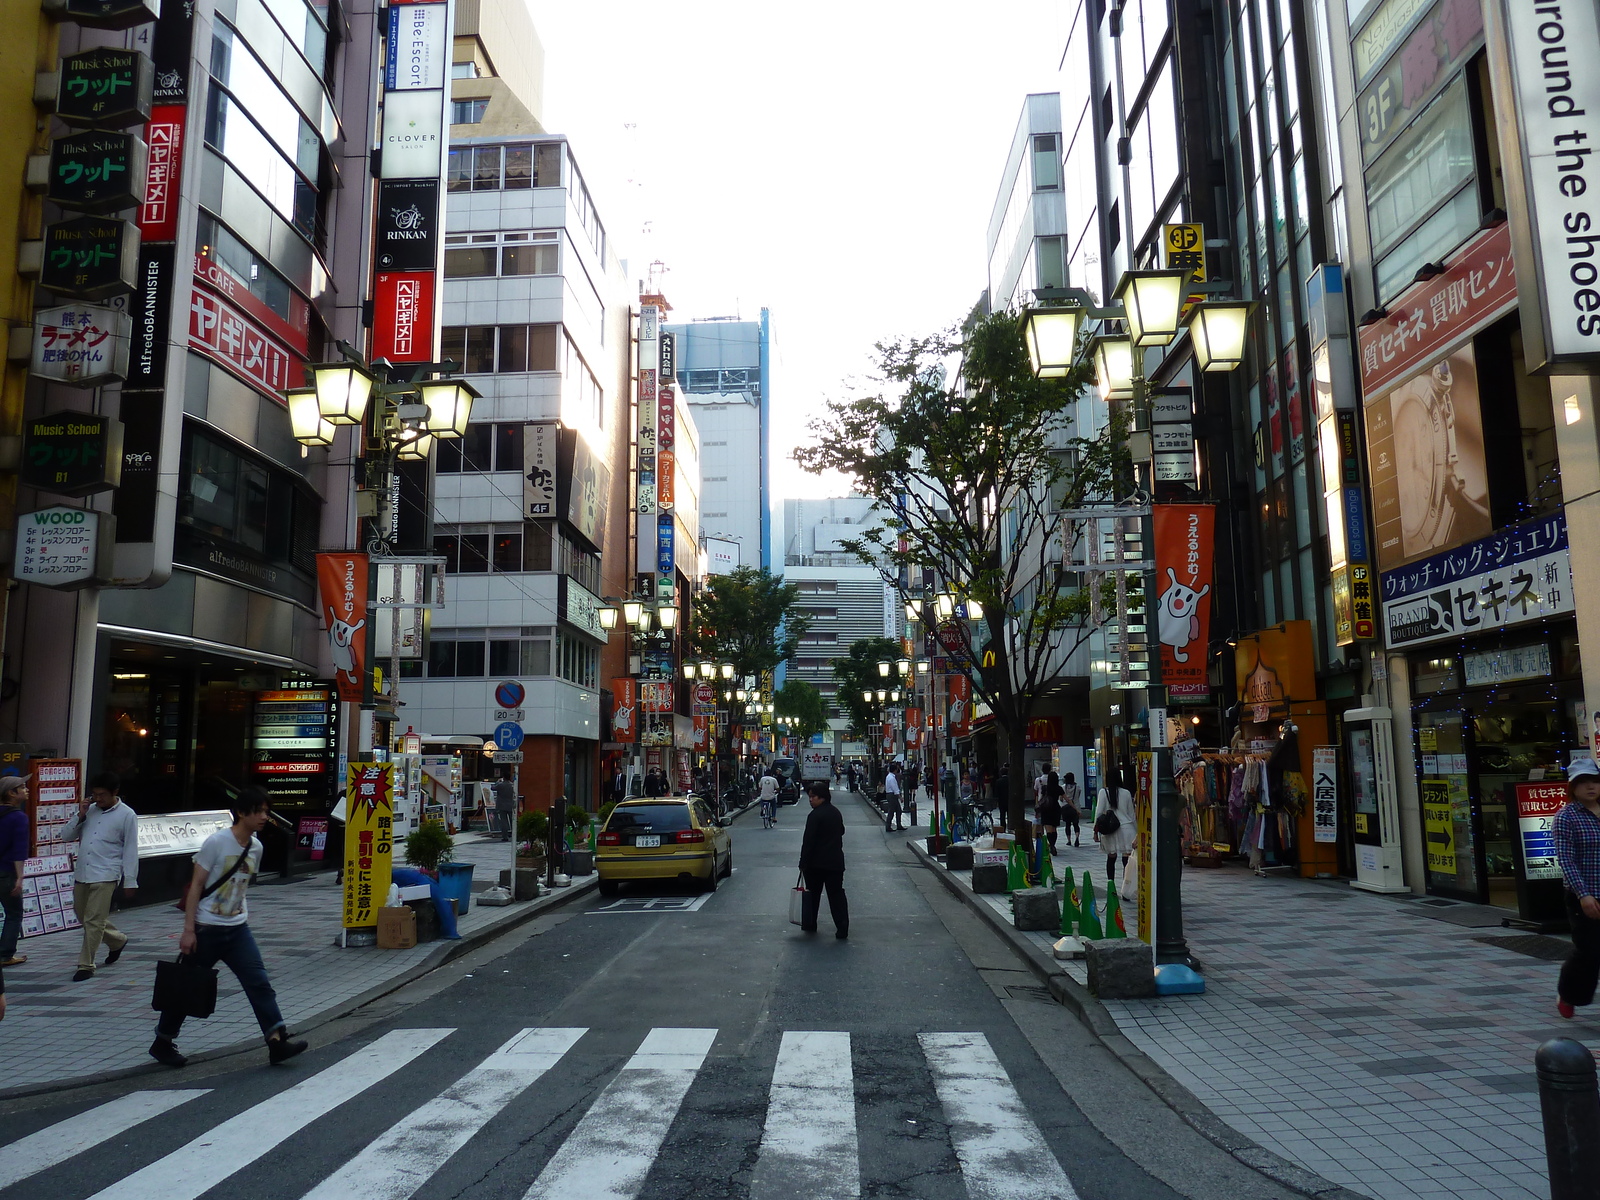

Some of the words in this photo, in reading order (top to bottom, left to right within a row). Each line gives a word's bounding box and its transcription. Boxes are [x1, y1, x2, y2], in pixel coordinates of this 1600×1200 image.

[138, 29, 148, 43] 4
[1362, 6, 1390, 54] Nail
[71, 59, 101, 71] Music
[103, 56, 132, 67] School
[1533, 0, 1586, 118] round
[67, 72, 132, 97] ウッド
[153, 88, 184, 97] RINKAN
[92, 102, 105, 112] 4F
[1367, 77, 1391, 142] 3F
[389, 134, 436, 142] CLOVER
[63, 144, 89, 154] Music
[93, 139, 125, 151] School
[59, 157, 126, 184] ウッド
[1553, 130, 1592, 198] the
[85, 190, 96, 199] 3F
[55, 229, 83, 240] Music
[88, 226, 117, 239] School
[387, 231, 427, 240] RINKAN
[1173, 229, 1195, 247] 3F
[51, 243, 116, 268] ウッド
[382, 256, 392, 264] 4F
[76, 274, 88, 284] 2F
[1563, 211, 1600, 337] shoes
[208, 267, 235, 296] CAFE
[62, 311, 92, 326] 熊本
[142, 260, 160, 374] alfredoBANNISTER
[42, 325, 110, 348] ラーメン
[43, 349, 103, 363] 肥後のれん
[662, 338, 671, 376] メトロ会館
[66, 364, 80, 375] 1F
[34, 424, 64, 436] Music
[67, 422, 101, 435] School
[30, 441, 100, 466] ウッド
[56, 472, 68, 483] B1
[526, 466, 554, 499] かっこ
[1348, 489, 1359, 513] ange
[532, 504, 548, 513] 4F
[34, 512, 85, 525] WOOD
[27, 527, 37, 535] 5F
[42, 527, 91, 535] レッスンフロアー
[1351, 514, 1362, 538] salon
[25, 546, 35, 554] 3F
[1352, 540, 1362, 557] Nail
[24, 556, 34, 564] 2F
[39, 556, 58, 564] ライブ
[209, 551, 277, 583] alfredoBANNISTER
[38, 565, 88, 574] レッスンフロアー
[1354, 568, 1365, 579] 3F
[1453, 568, 1541, 628] セキネ
[1390, 604, 1429, 629] BRAND
[1391, 622, 1430, 640] BOUTIQUE
[1176, 668, 1202, 676] 中央通り
[1170, 684, 1208, 692] ホームメイト
[331, 715, 336, 723] 7
[330, 727, 336, 735] 6
[329, 739, 336, 747] 5
[3, 752, 21, 762] 3F
[1315, 772, 1335, 827] 入居募集
[1423, 791, 1448, 802] ブランド
[1528, 787, 1567, 800] 質セキネ
[1425, 809, 1450, 821] 買います
[377, 817, 391, 854] 路上の
[1428, 853, 1454, 866] 売ります
